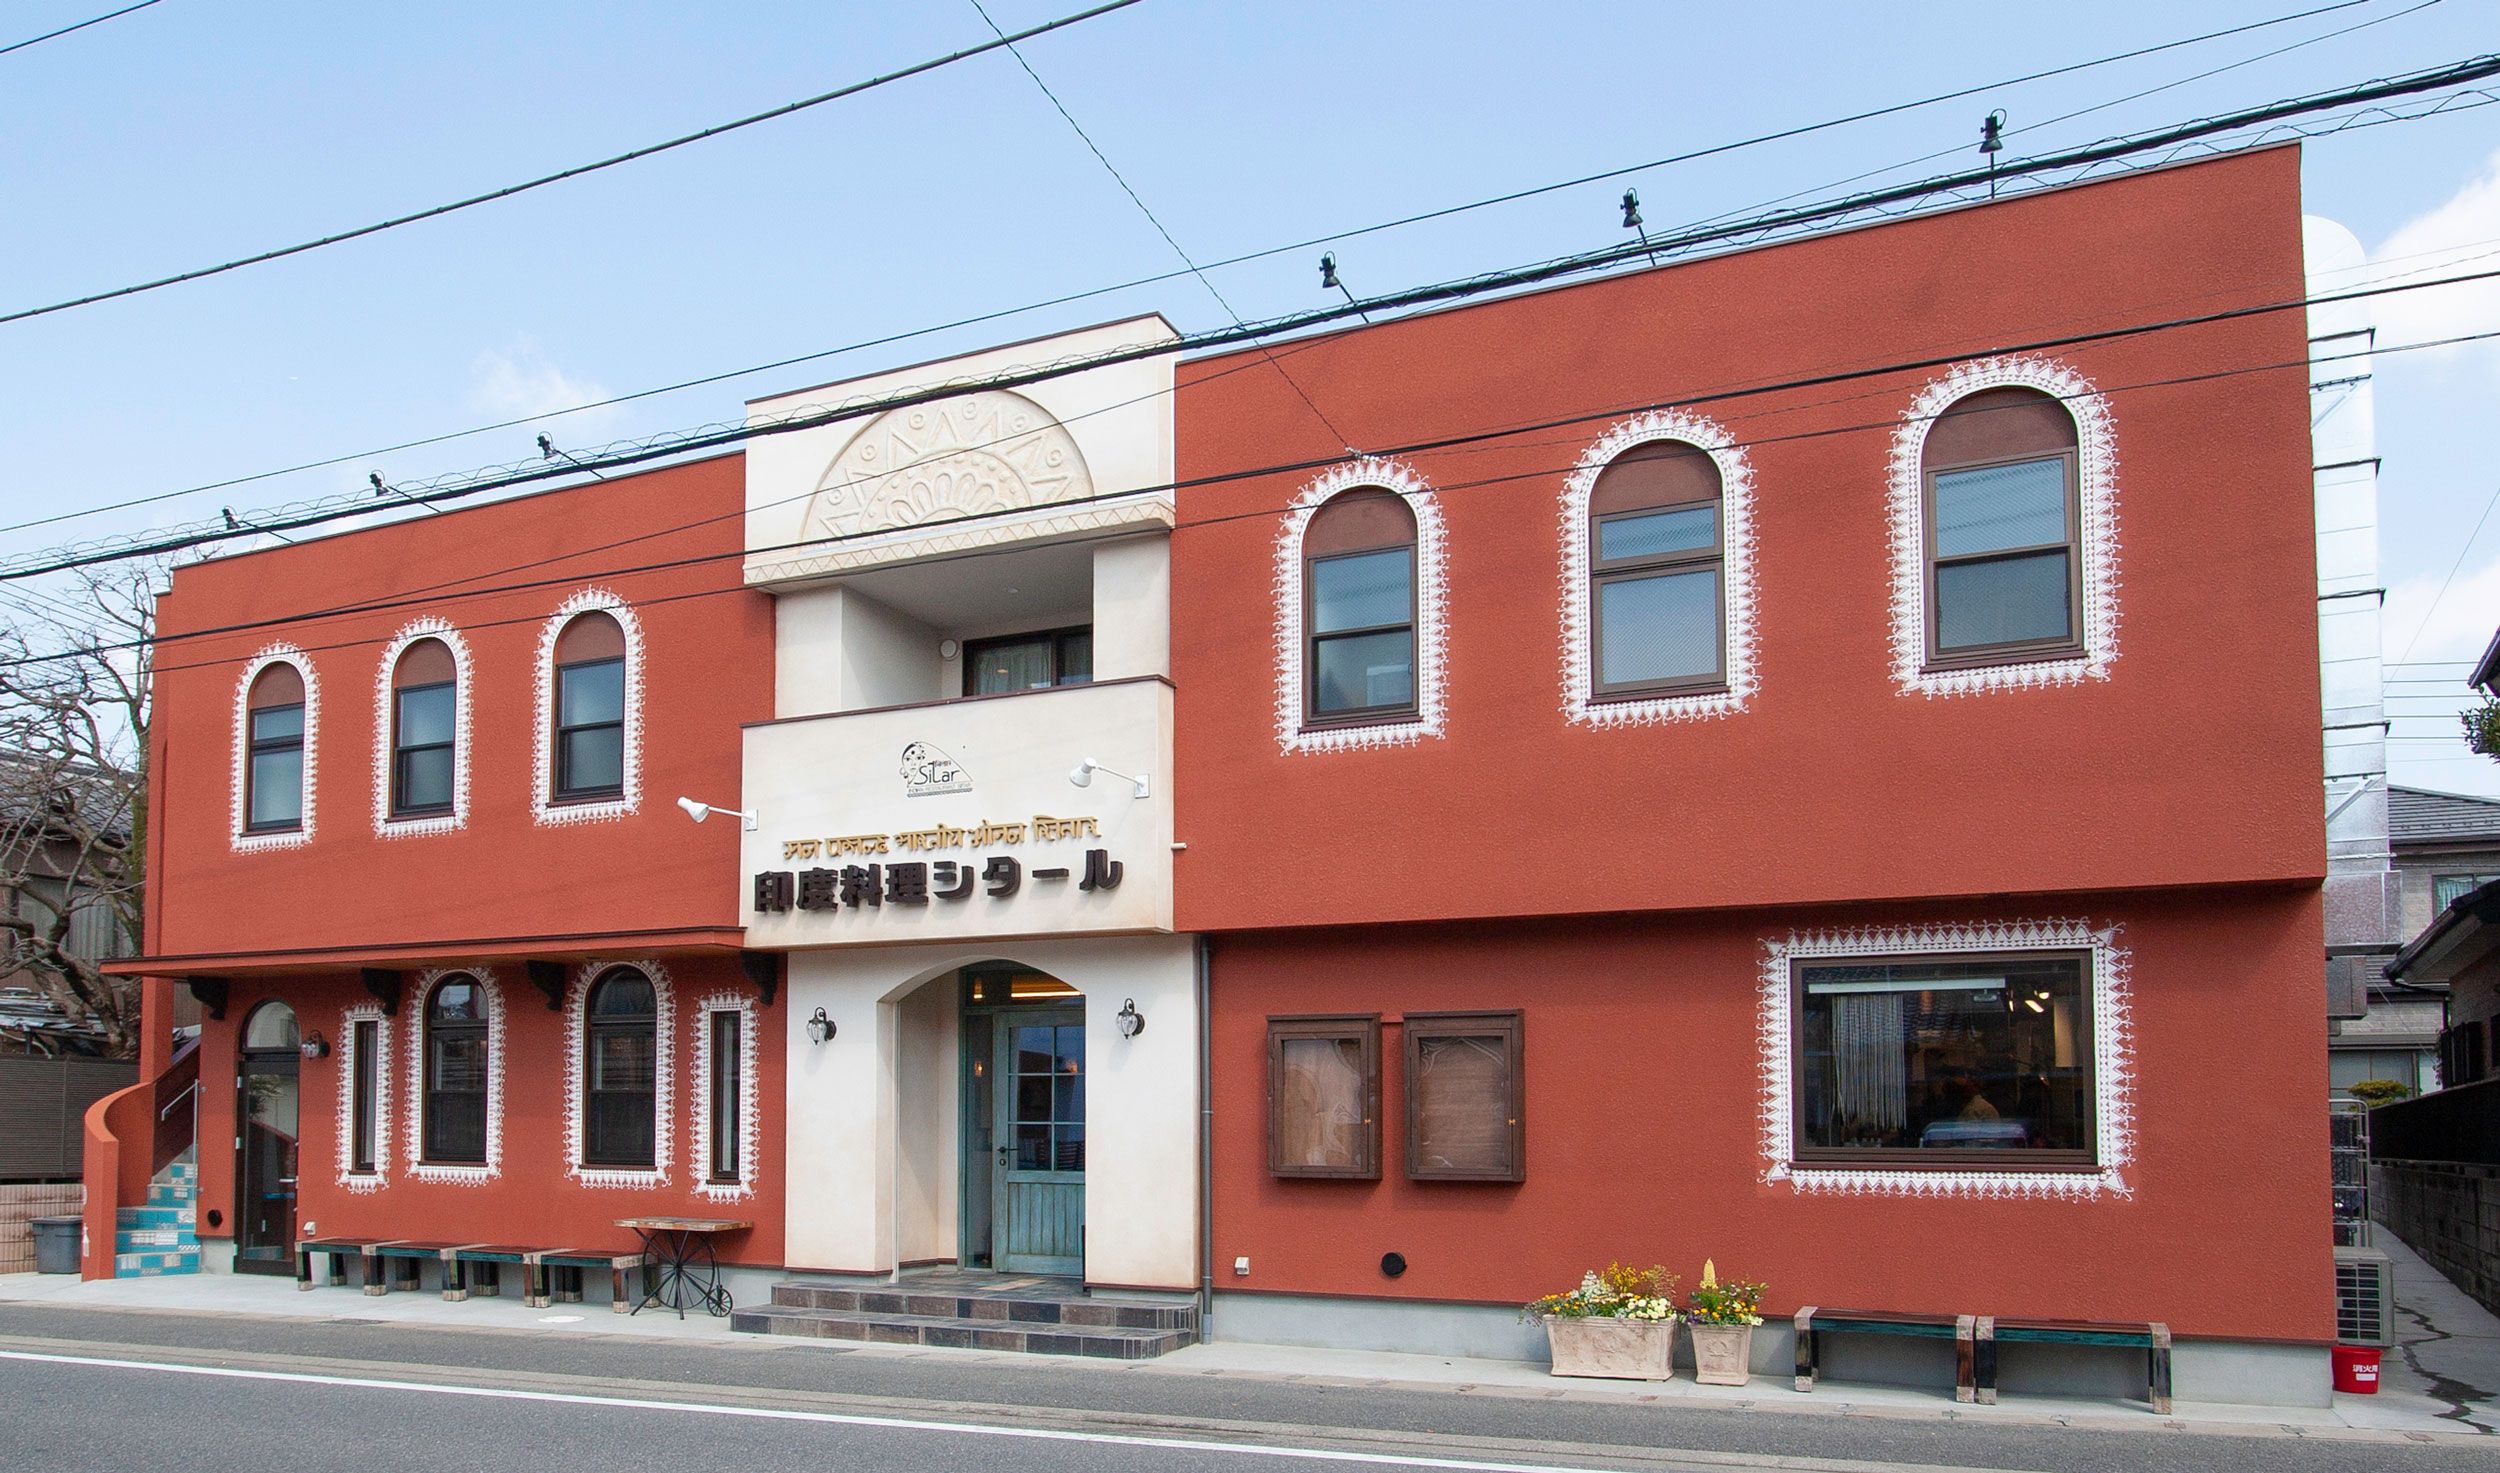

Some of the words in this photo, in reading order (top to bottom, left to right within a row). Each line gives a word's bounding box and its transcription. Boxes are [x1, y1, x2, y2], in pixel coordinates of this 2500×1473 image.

[754, 849, 1123, 912] 印度料理シタール
